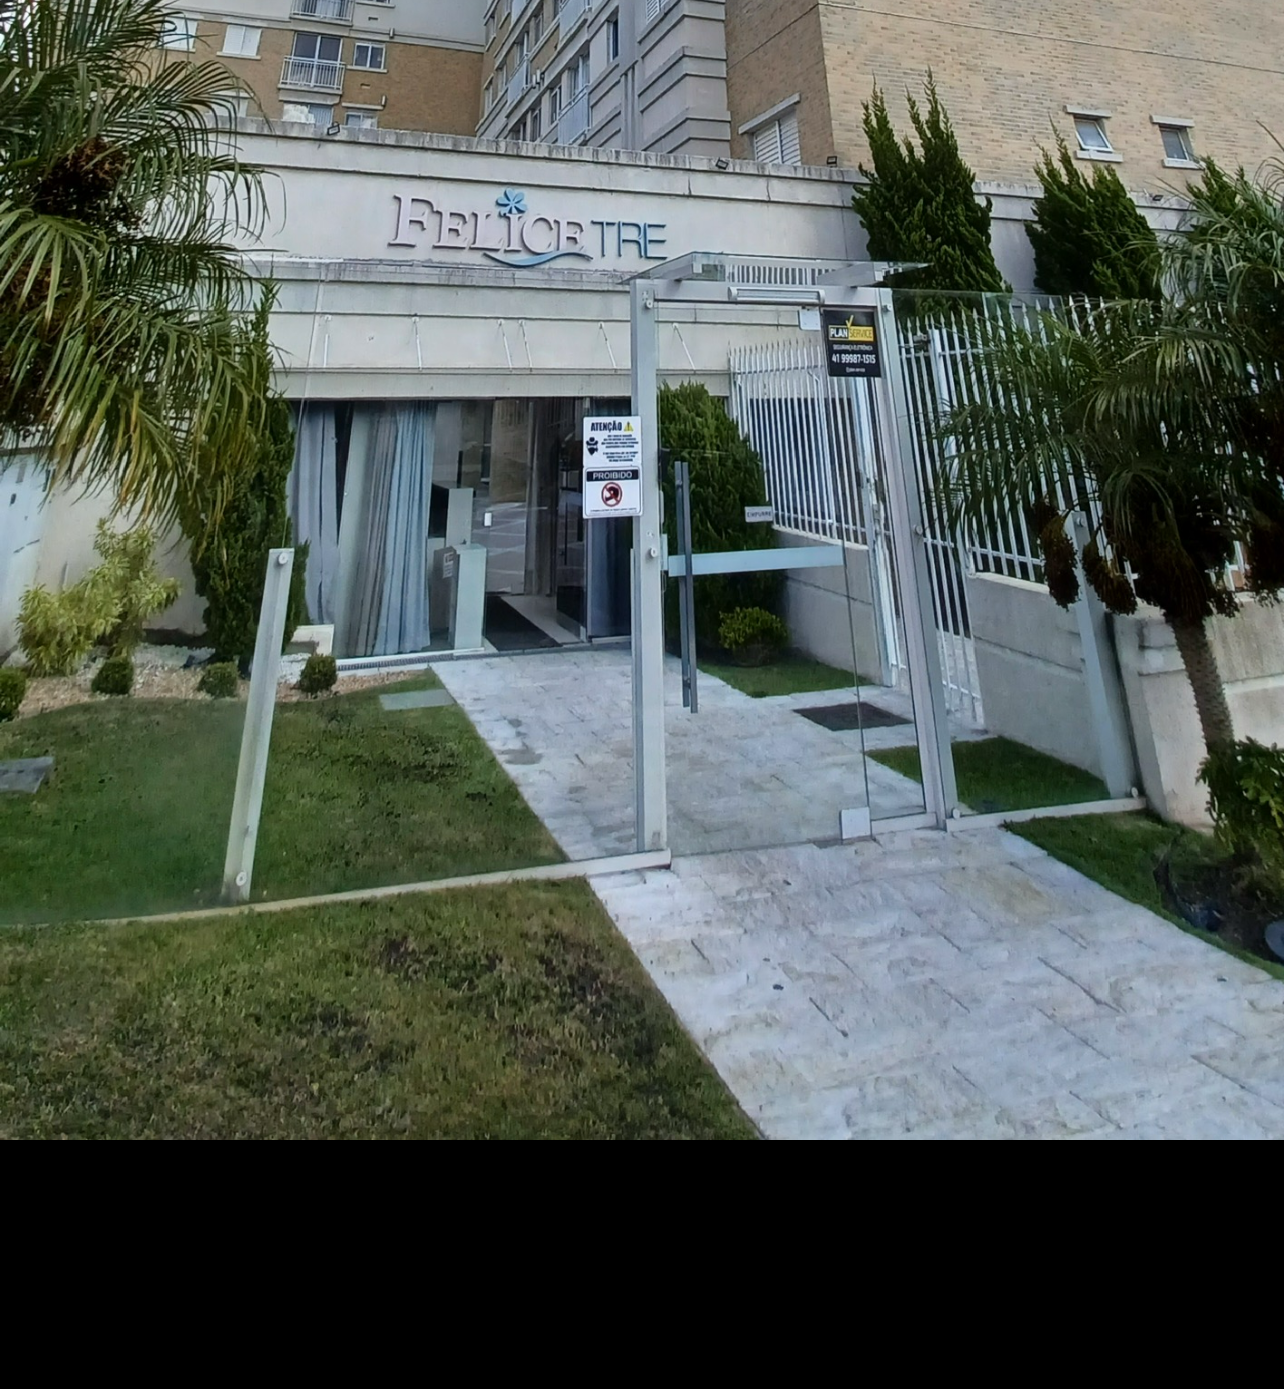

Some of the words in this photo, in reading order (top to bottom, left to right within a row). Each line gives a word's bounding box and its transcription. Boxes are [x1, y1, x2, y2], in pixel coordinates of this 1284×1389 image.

[388, 194, 585, 254] FELICE
[591, 220, 669, 260] TRE
[830, 327, 848, 338] PLAN
[849, 328, 873, 338] SERVICE
[831, 353, 840, 363] 41
[590, 420, 623, 432] ATENÇÃO
[592, 471, 633, 480] PROIBIDO
